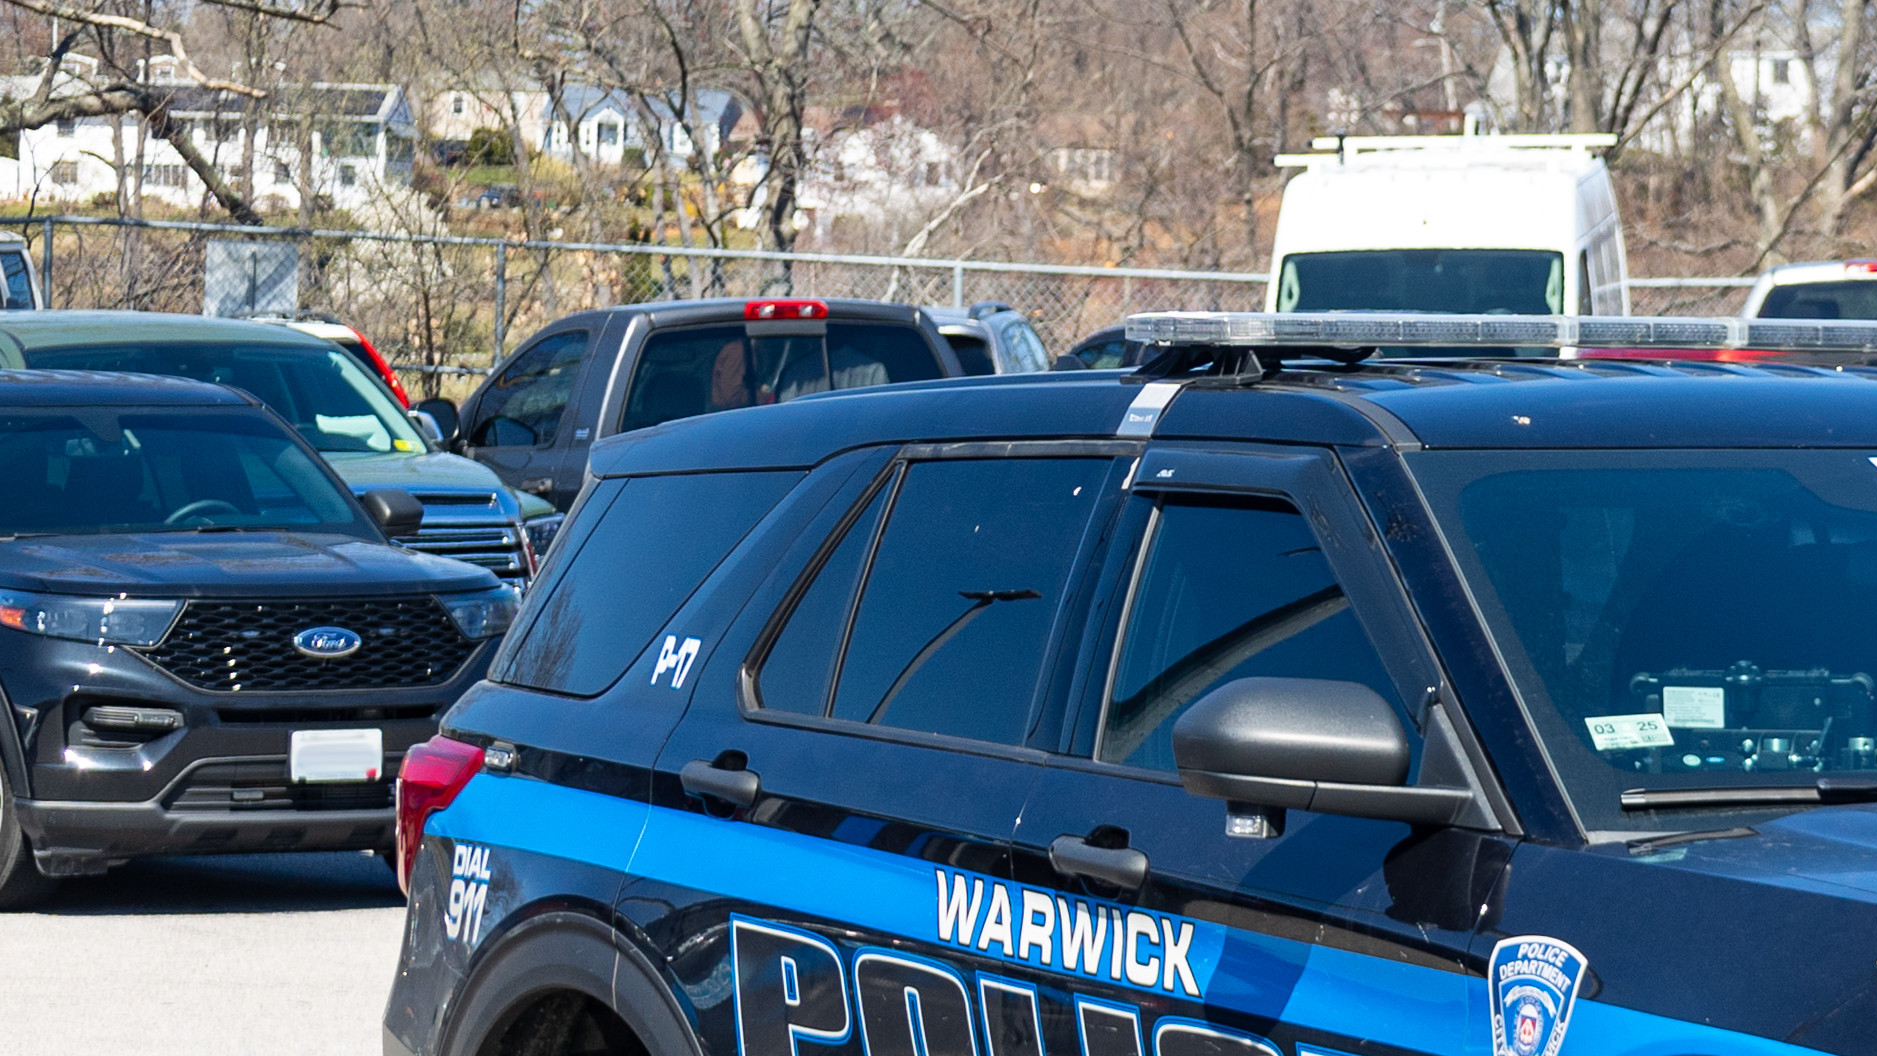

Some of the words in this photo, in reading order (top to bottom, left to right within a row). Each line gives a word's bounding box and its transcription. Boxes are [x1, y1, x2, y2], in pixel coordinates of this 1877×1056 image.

[650, 635, 701, 689] P-17
[1594, 723, 1616, 735] 03
[1636, 720, 1658, 731] 25
[452, 843, 491, 881] DIAL
[444, 879, 488, 944] 911
[935, 868, 1203, 997] WARWICK
[1517, 943, 1569, 968] POLICE
[1499, 960, 1572, 993] DEPARTMENT
[1494, 1014, 1508, 1056] CITY
